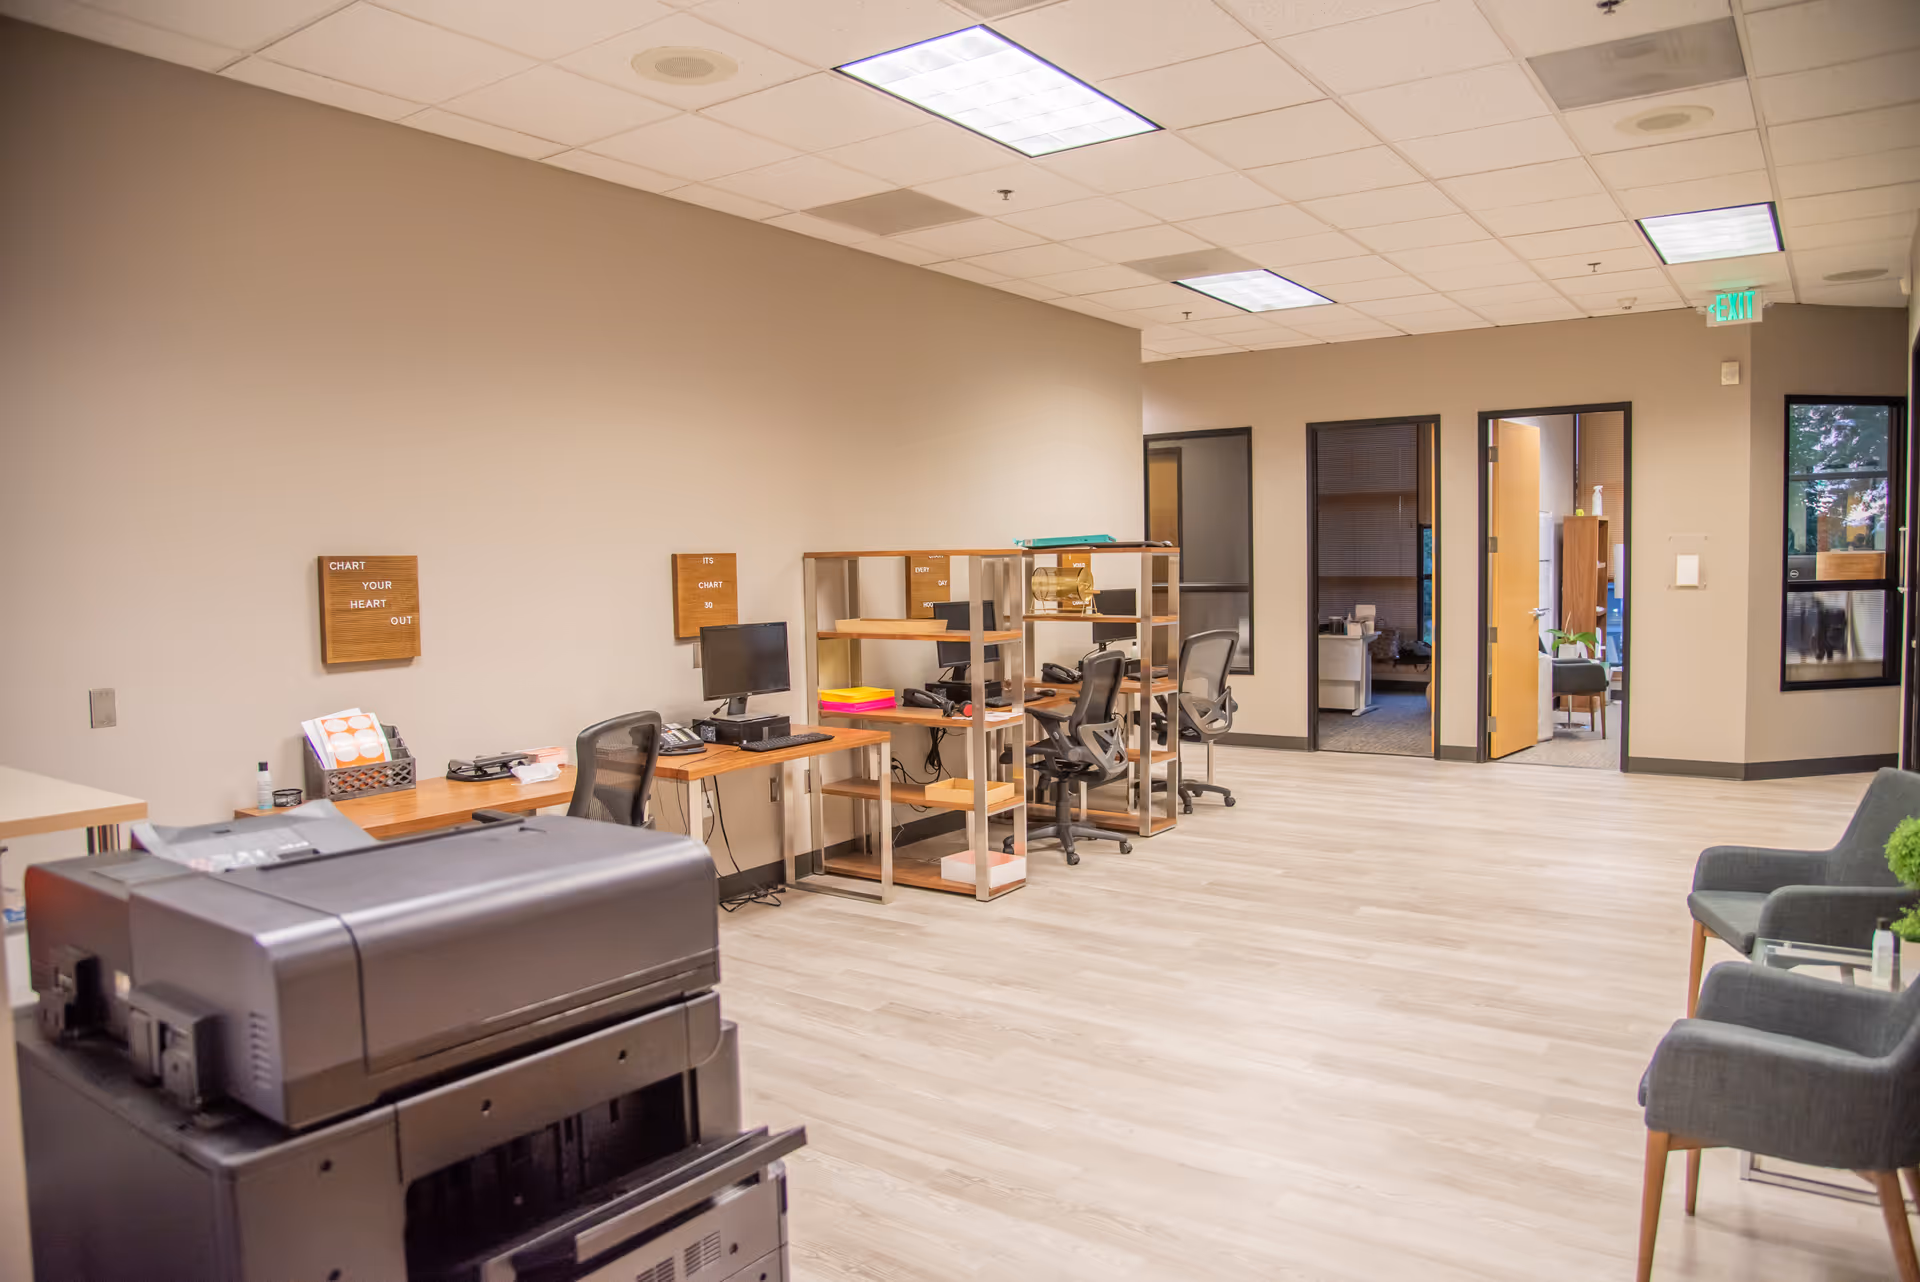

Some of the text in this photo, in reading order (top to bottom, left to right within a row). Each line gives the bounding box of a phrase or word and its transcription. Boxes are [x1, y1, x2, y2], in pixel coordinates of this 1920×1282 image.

[1715, 290, 1756, 322] EXIT
[329, 561, 366, 570] CHART
[361, 580, 392, 590] YOUR
[698, 581, 723, 589] CHART
[350, 599, 387, 609] HEART
[390, 616, 413, 625] OUT
